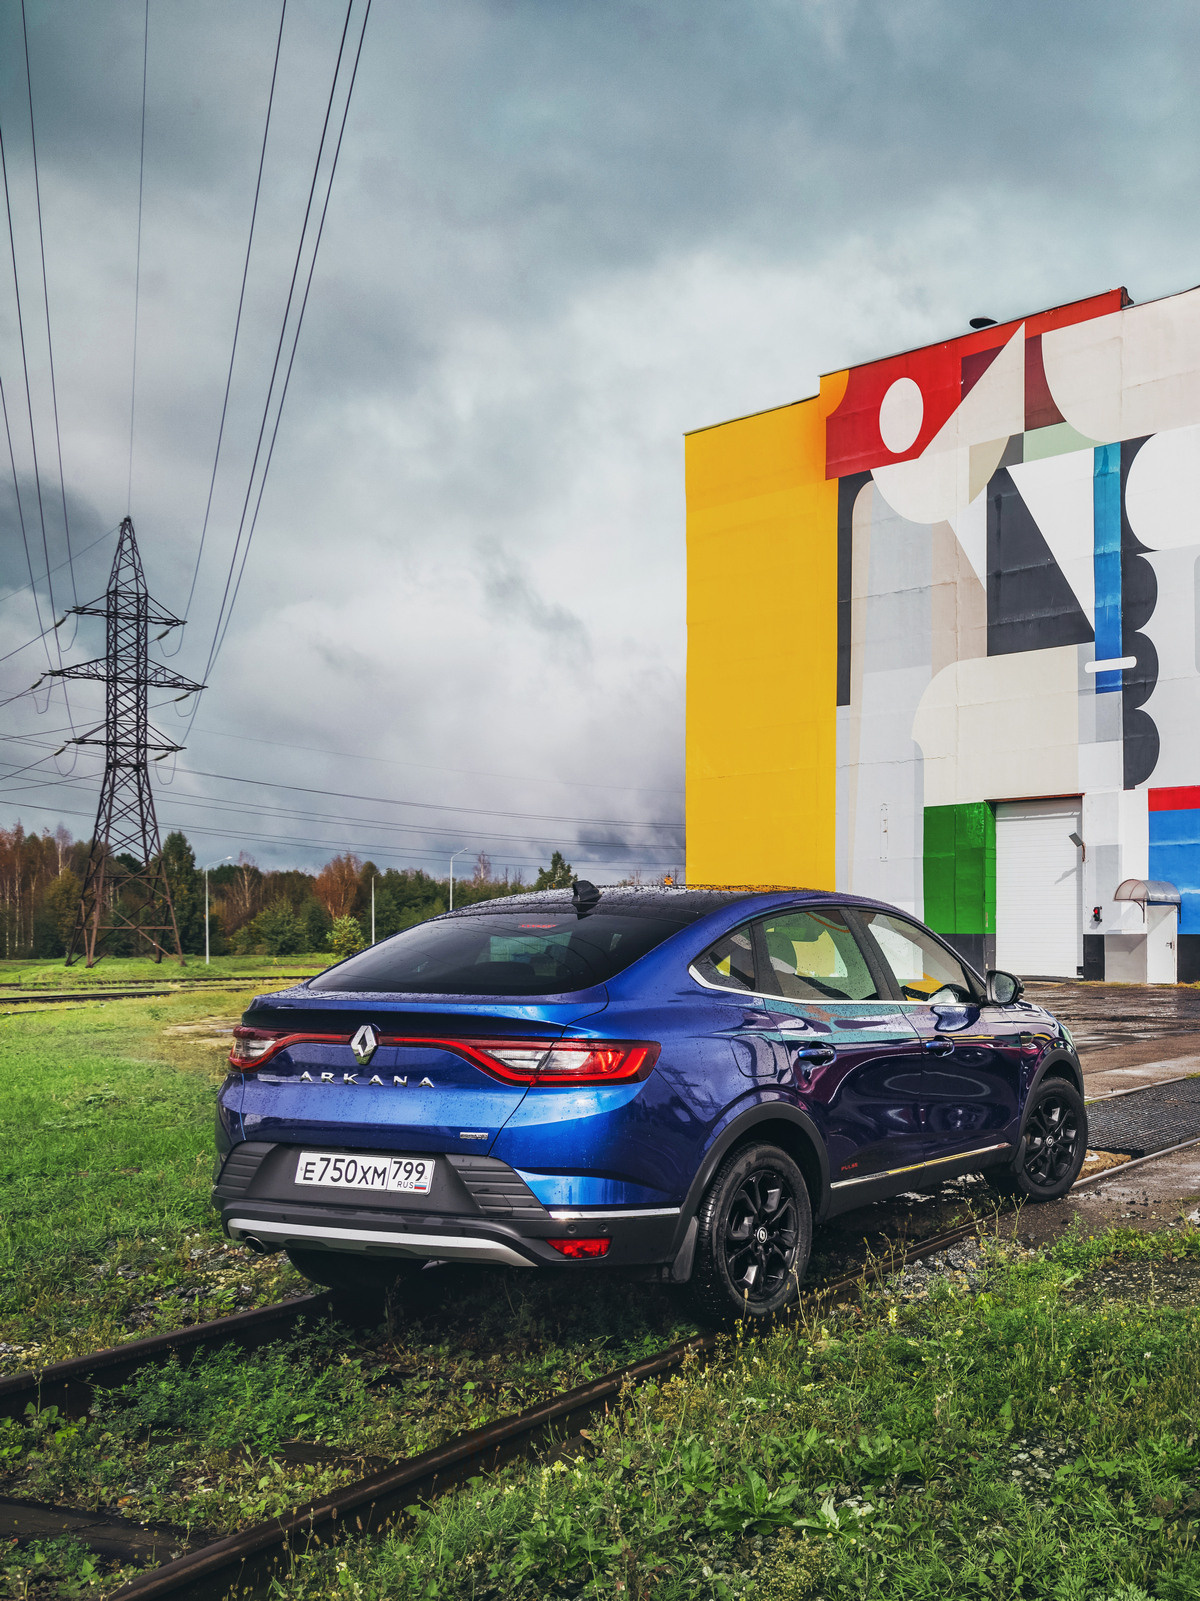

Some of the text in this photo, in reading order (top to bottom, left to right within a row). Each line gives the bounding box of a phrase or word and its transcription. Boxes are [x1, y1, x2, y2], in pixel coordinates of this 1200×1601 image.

[300, 1071, 435, 1088] ARKANA
[303, 1157, 426, 1186] E750XM 799
[396, 1181, 414, 1189] RUS
